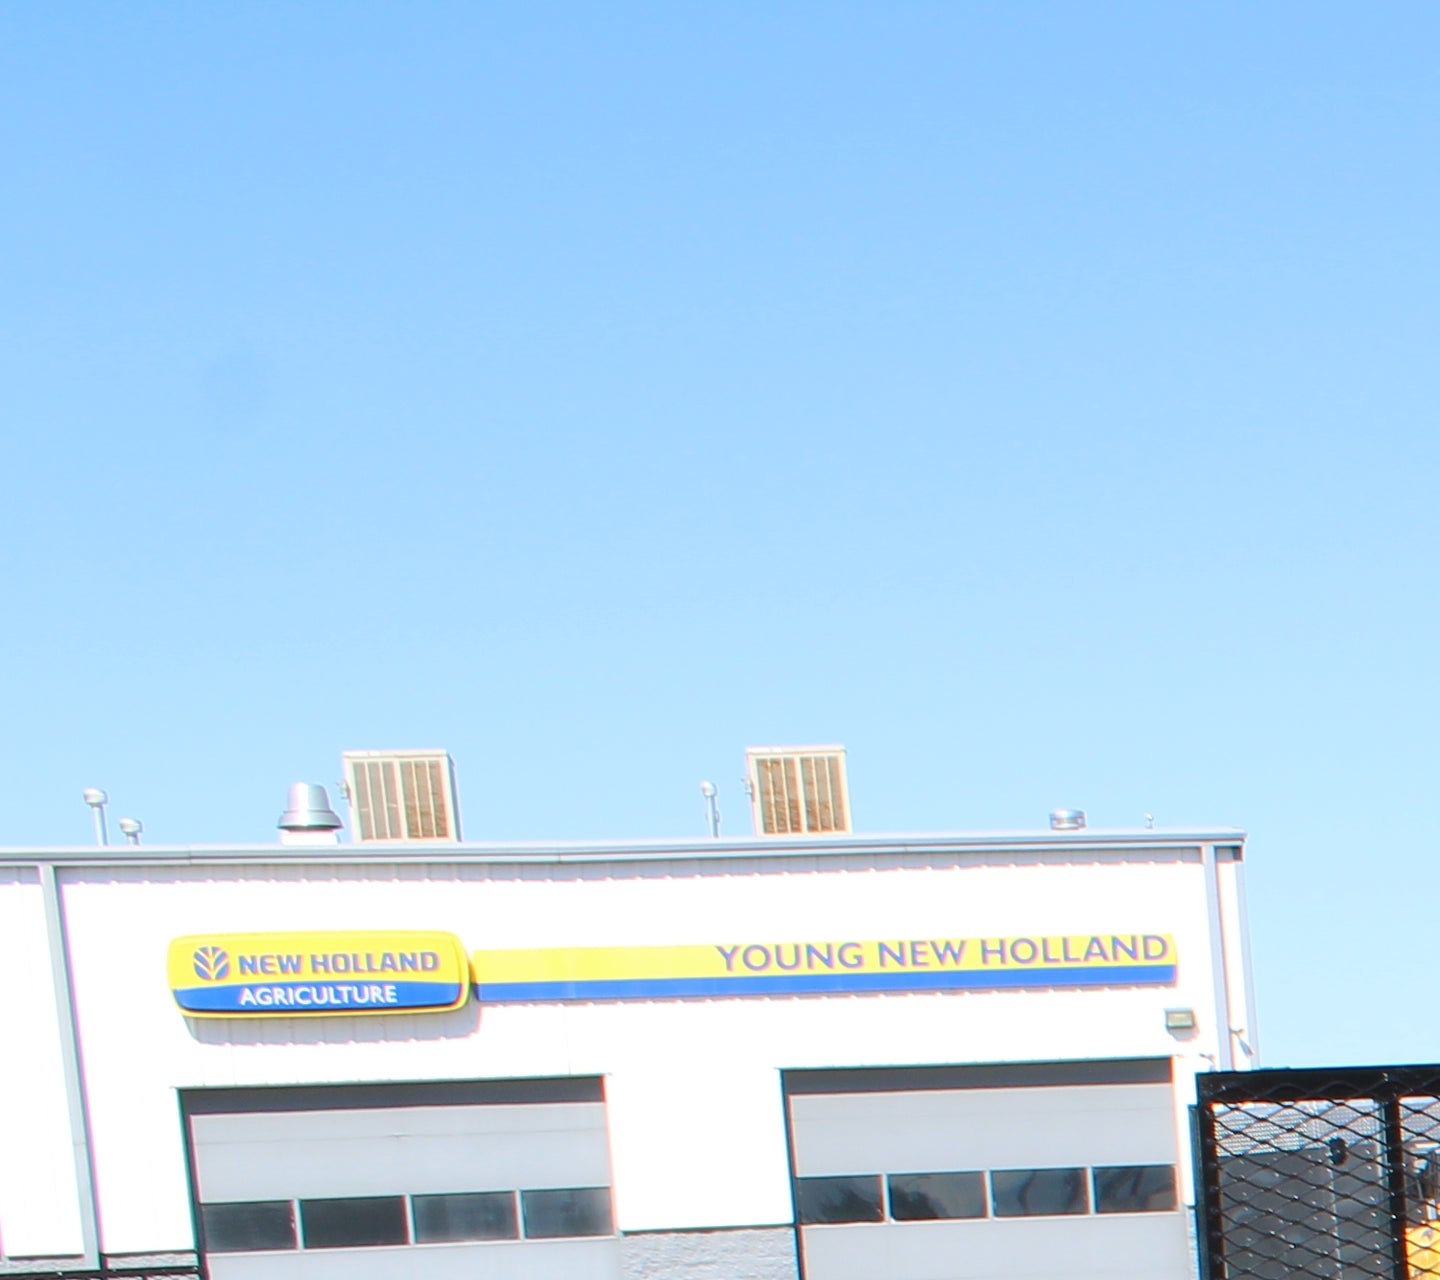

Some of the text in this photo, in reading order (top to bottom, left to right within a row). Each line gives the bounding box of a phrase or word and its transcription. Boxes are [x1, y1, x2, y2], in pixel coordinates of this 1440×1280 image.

[238, 951, 440, 975] NEW HOLLAND
[715, 935, 1169, 972] YOUNG NEW HOLLAND
[239, 985, 398, 1006] AGRICULTURE
